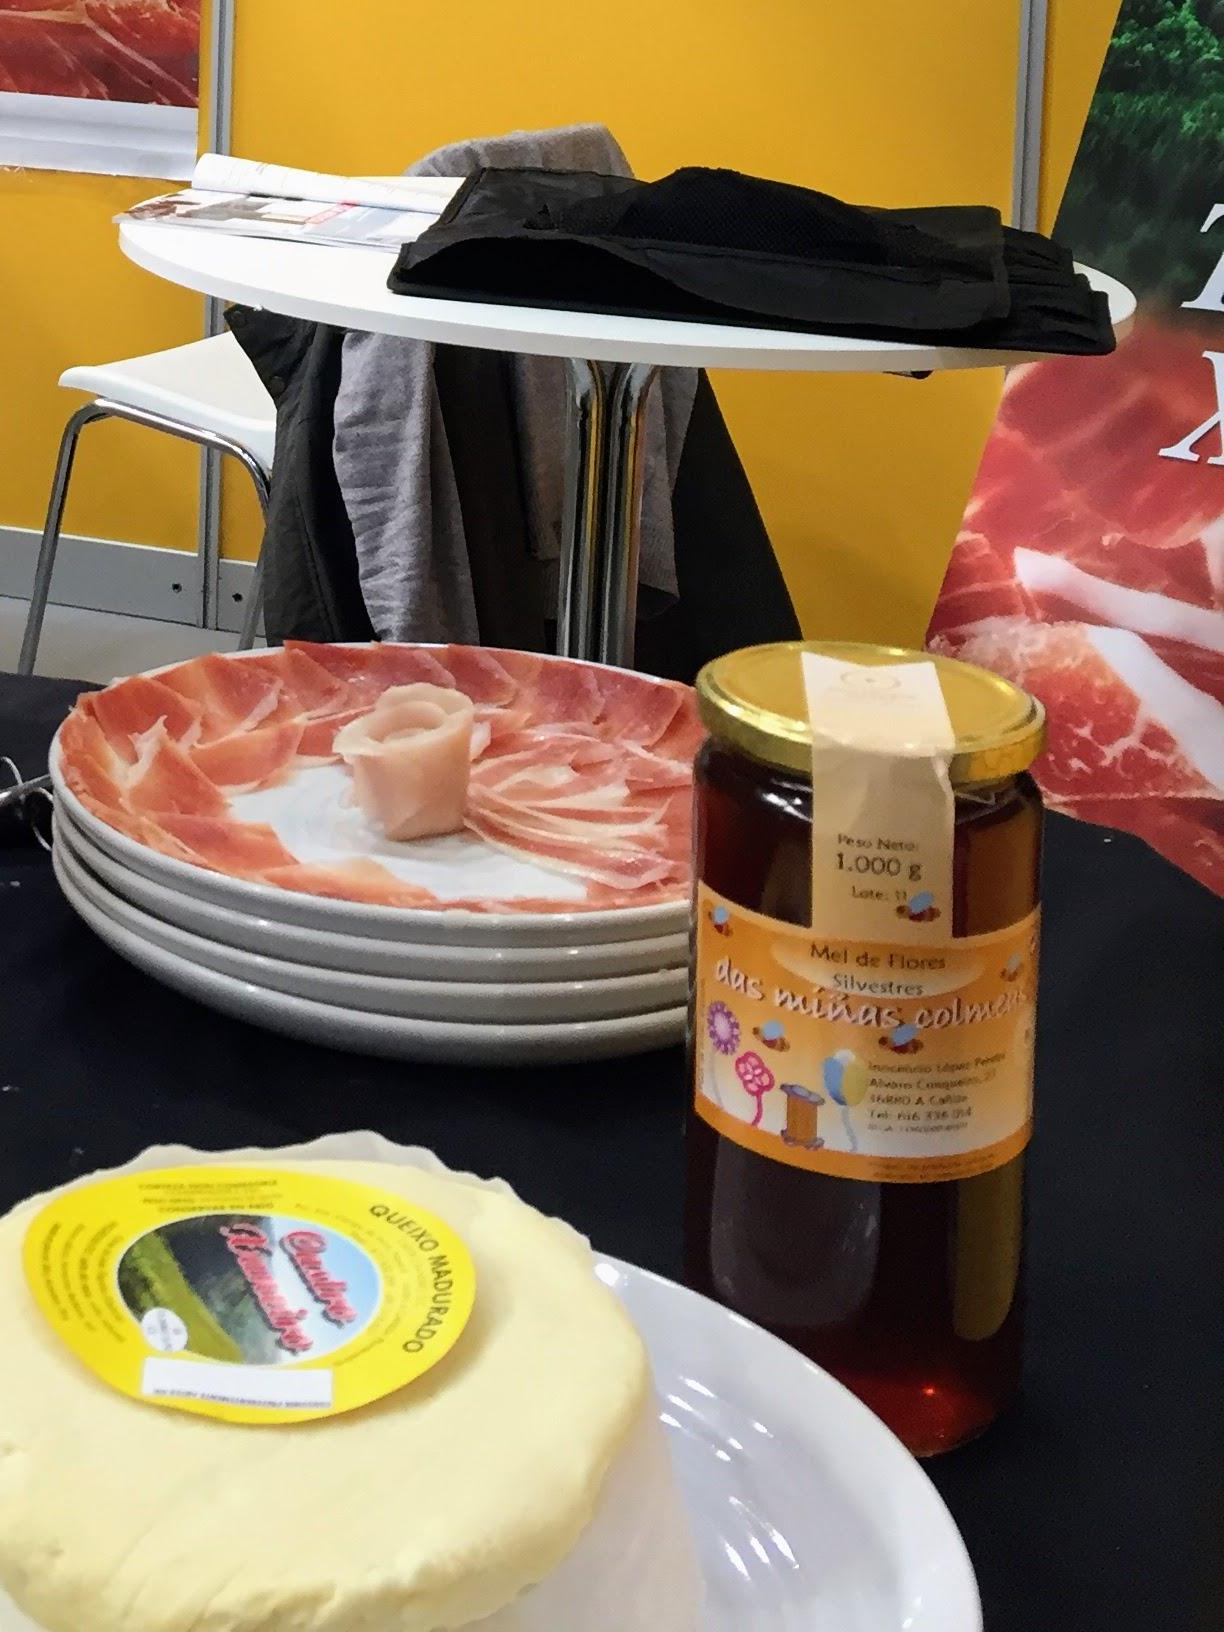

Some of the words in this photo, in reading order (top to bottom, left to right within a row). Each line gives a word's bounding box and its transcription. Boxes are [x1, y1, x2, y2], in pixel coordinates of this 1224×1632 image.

[837, 852, 901, 878] 1.000
[908, 863, 922, 882] g
[810, 942, 848, 965] Mel
[855, 950, 881, 968] de
[887, 952, 946, 971] Flores
[713, 954, 765, 1001] das
[831, 972, 925, 997] Silvestres
[369, 1204, 440, 1252] QUEIXO
[401, 1254, 454, 1353] MADURADO
